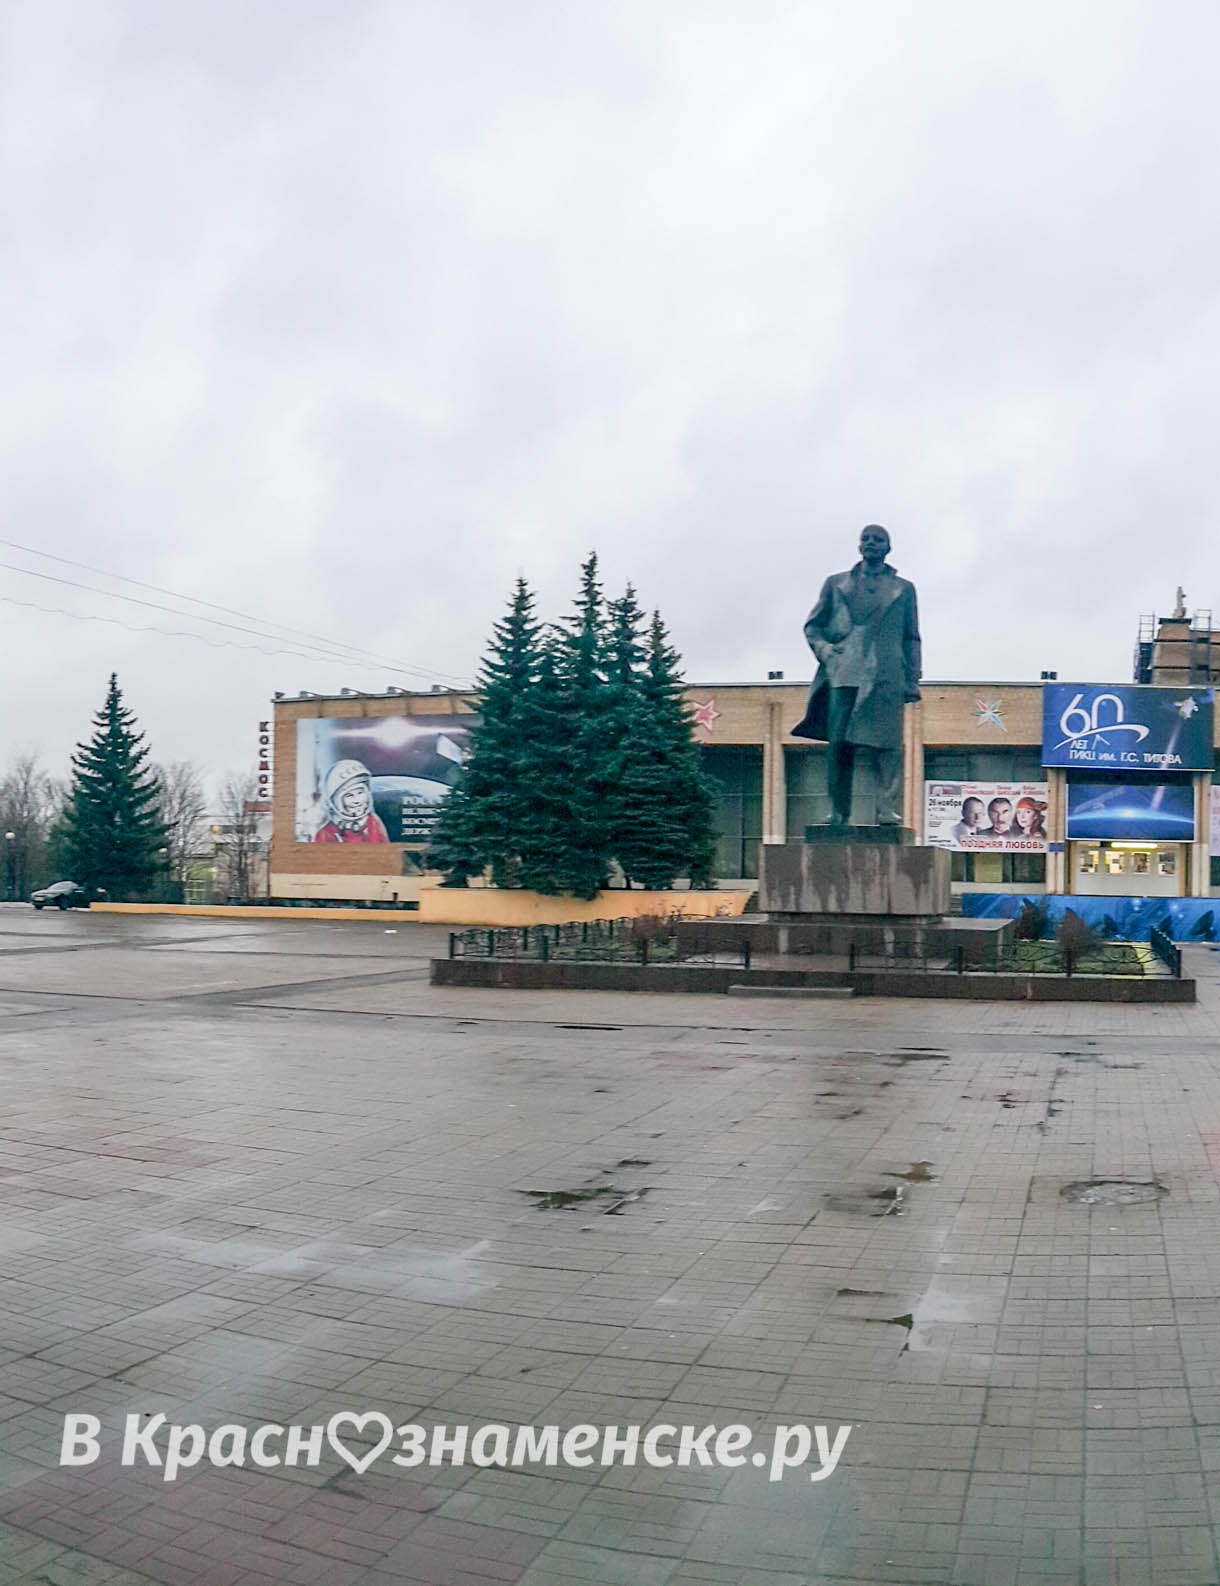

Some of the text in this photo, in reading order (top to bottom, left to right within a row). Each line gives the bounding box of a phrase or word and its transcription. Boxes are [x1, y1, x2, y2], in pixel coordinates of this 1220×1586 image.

[1070, 739, 1088, 749] ЛЕТ
[258, 721, 270, 798] КОСМОС
[1069, 750, 1096, 761] ГИКЦ
[1143, 753, 1182, 764] ТИТОВА
[960, 840, 1003, 849] ПОЗДНЯЯ
[1005, 840, 1044, 849] ЛЮБОВЬ
